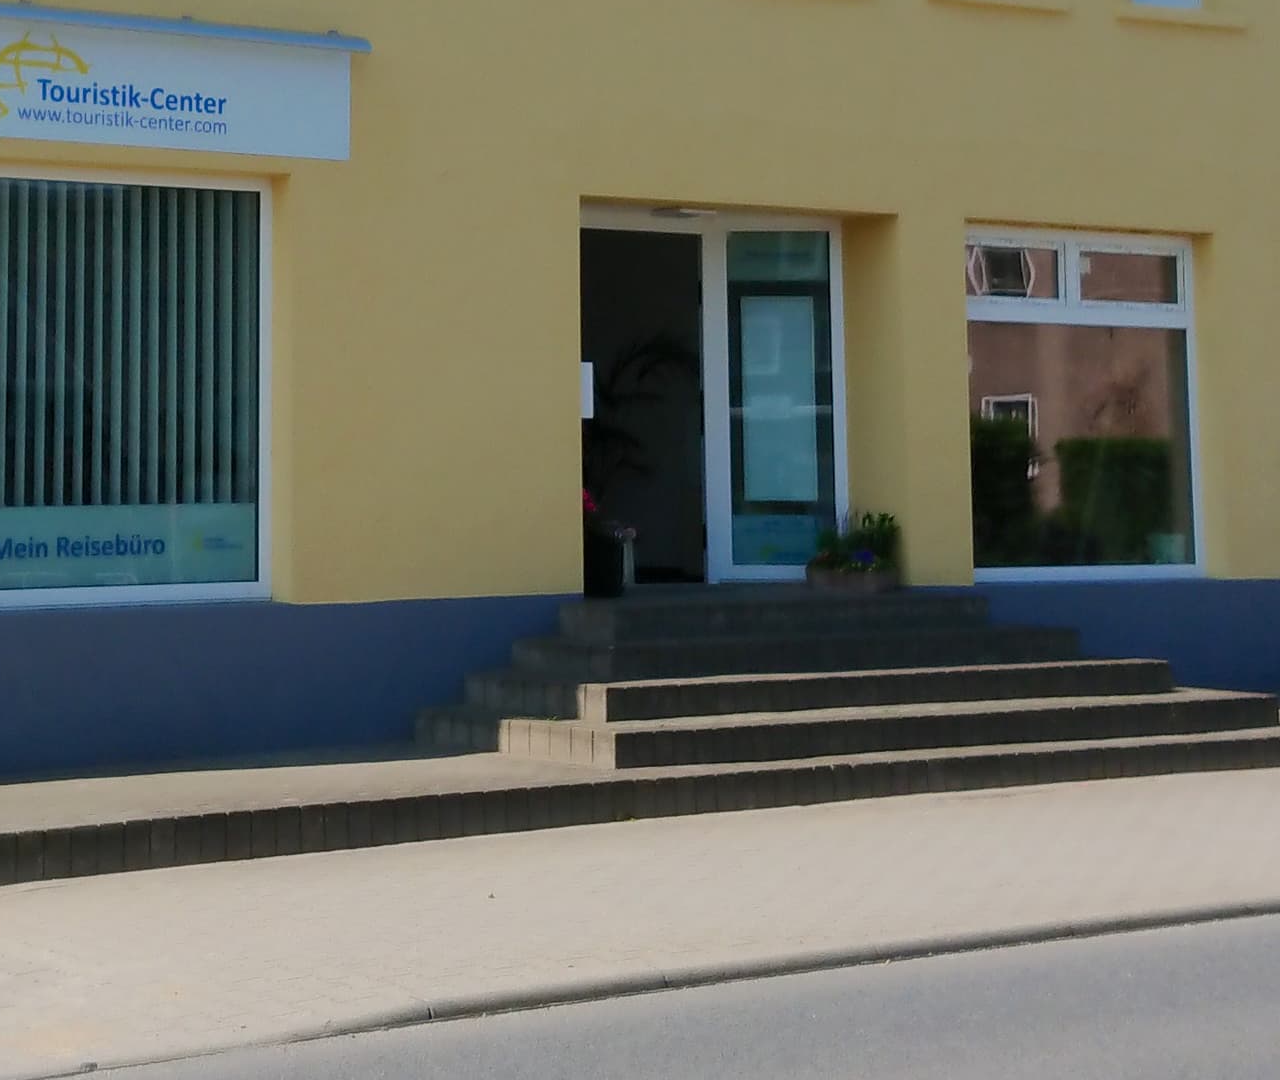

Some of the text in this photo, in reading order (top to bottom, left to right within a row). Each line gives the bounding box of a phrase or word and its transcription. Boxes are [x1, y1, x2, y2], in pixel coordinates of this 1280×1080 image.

[37, 78, 227, 114] Touristik-Center
[17, 107, 227, 134] www.touristik-center.com
[56, 533, 166, 558] Reisebüro
